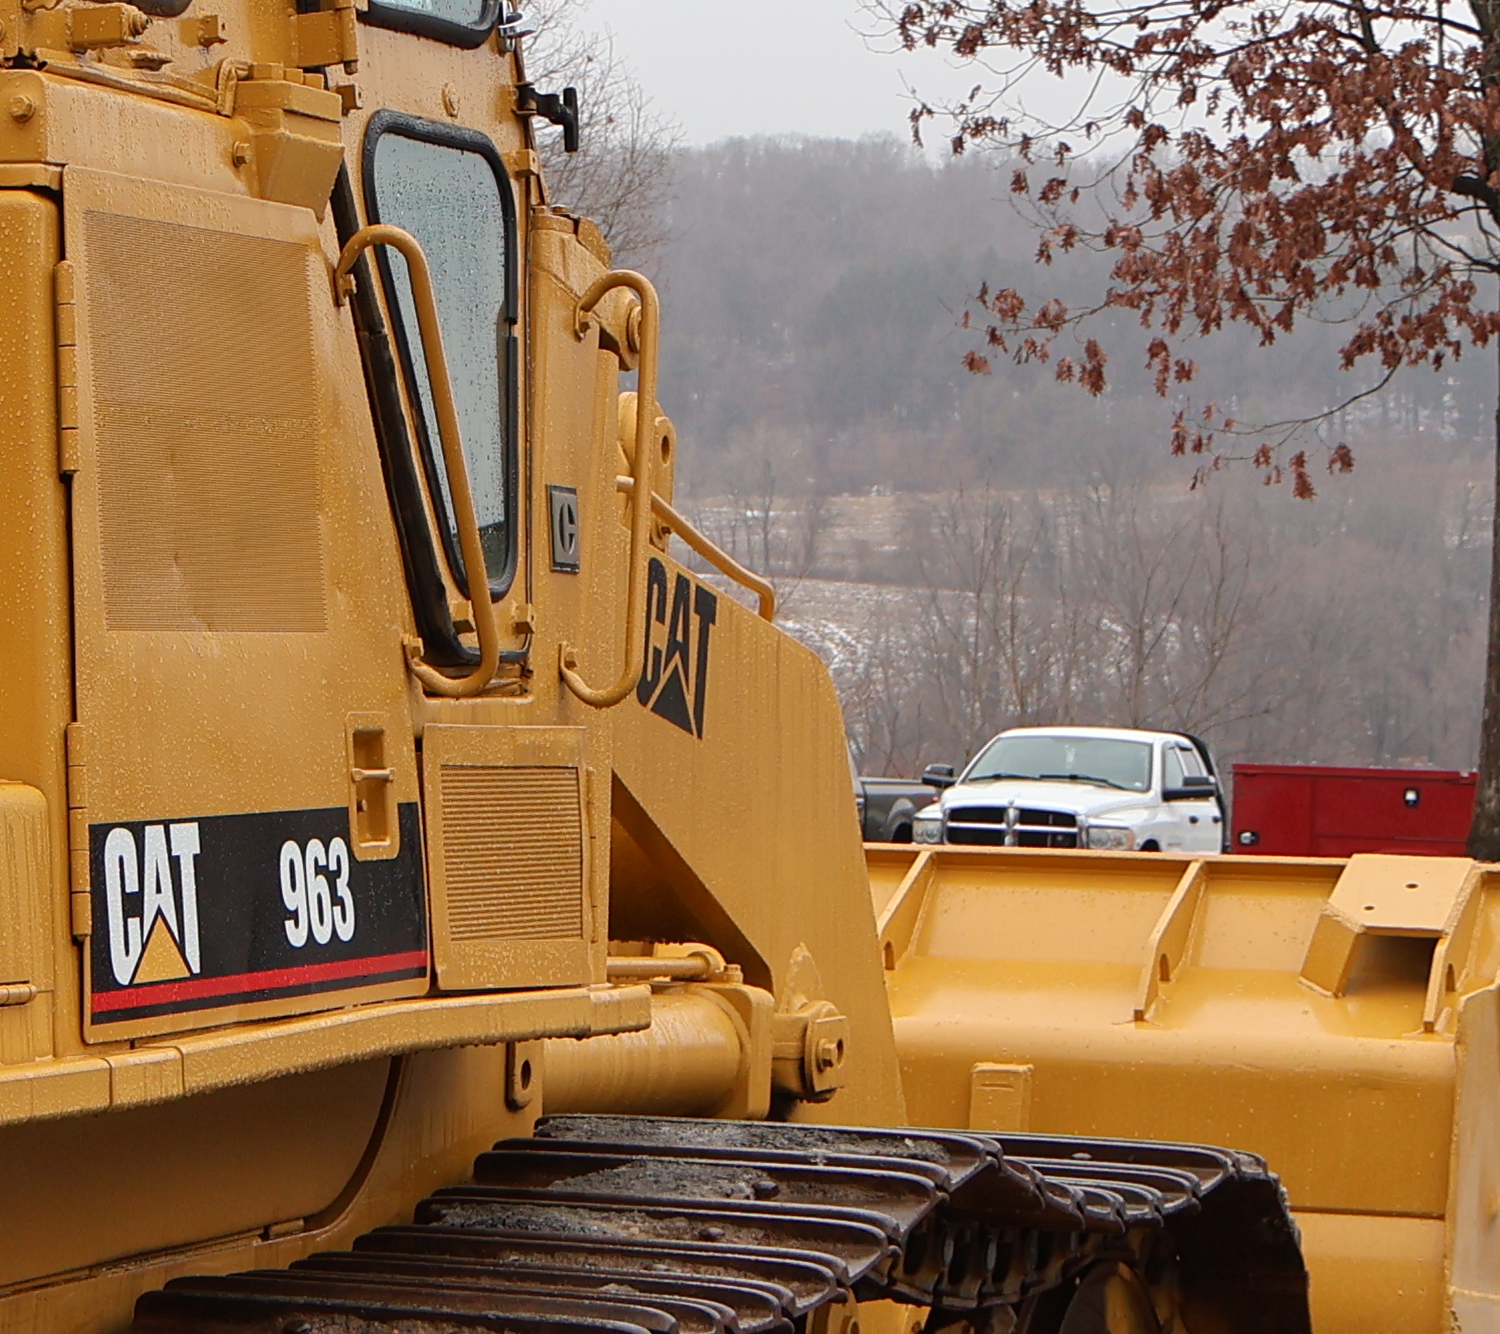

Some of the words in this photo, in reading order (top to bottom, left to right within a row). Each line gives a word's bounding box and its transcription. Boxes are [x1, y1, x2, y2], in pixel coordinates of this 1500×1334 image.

[636, 556, 718, 741] CAT
[104, 822, 201, 986] CAT
[279, 836, 355, 948] 963
